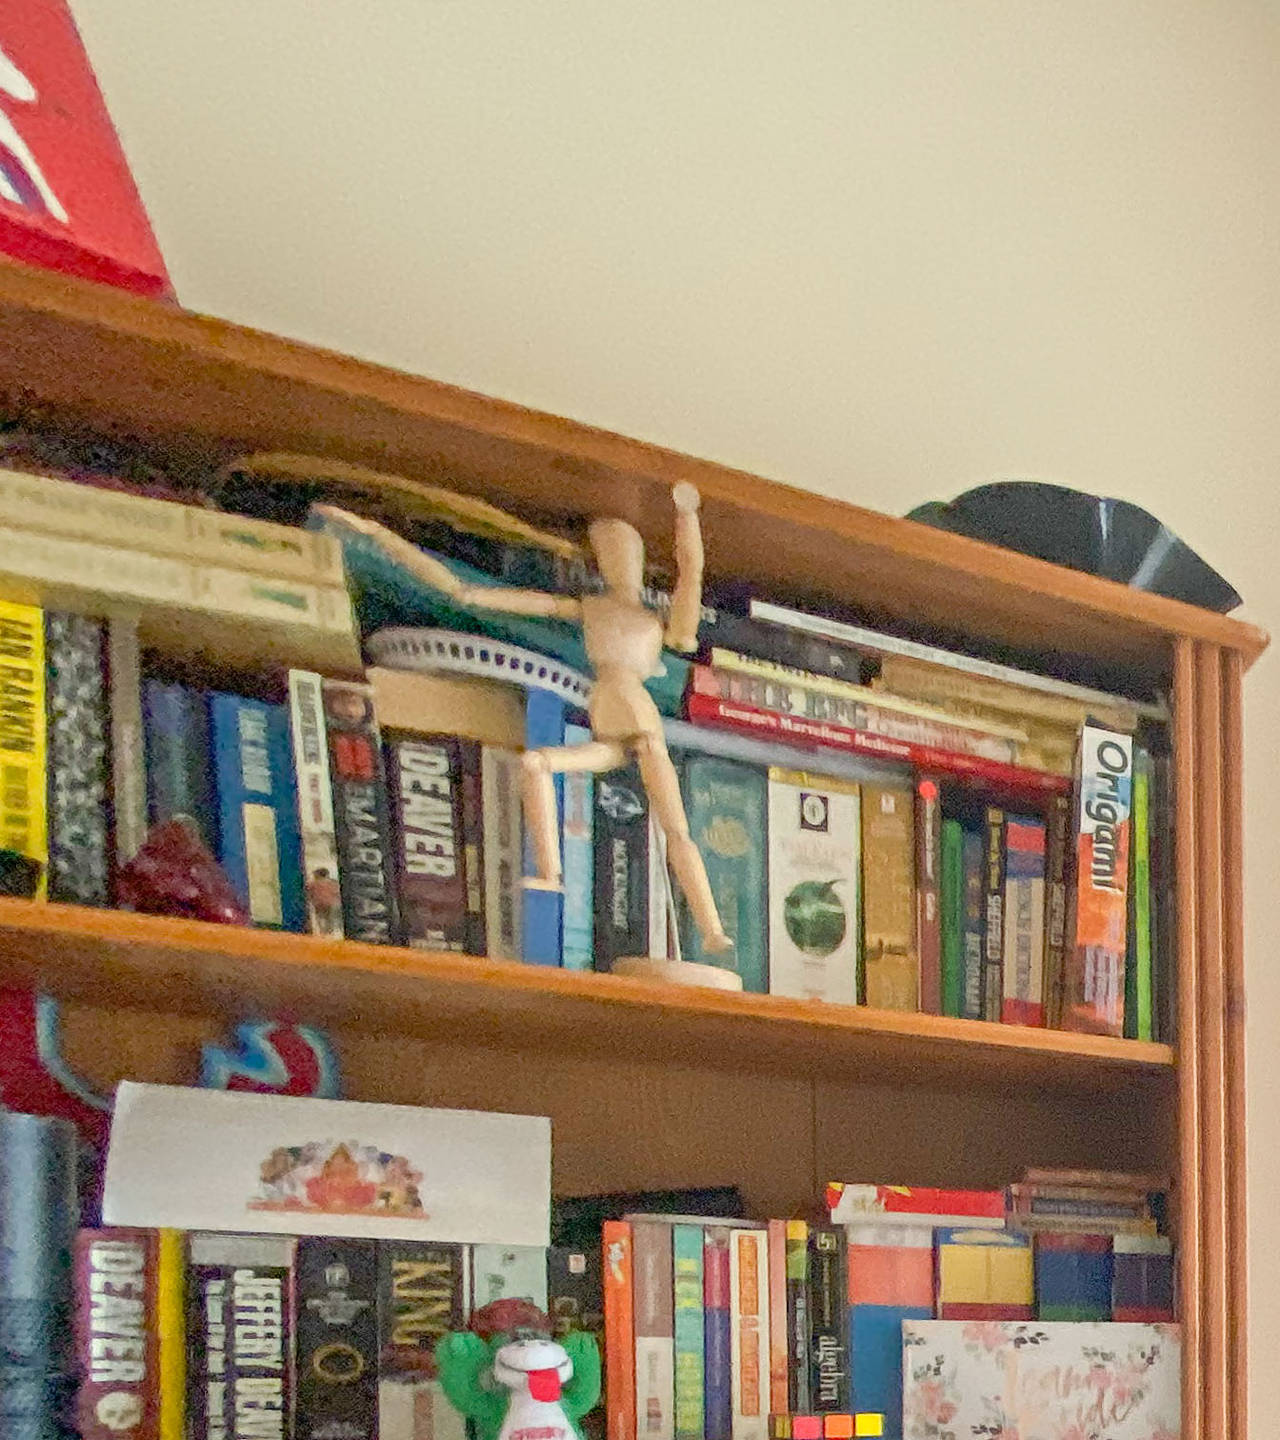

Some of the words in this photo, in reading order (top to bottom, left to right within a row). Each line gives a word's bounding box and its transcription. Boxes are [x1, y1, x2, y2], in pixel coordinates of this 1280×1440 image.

[347, 797, 392, 941] MARTIAN
[402, 740, 456, 878] DEAVER
[1090, 740, 1129, 896] Origami
[90, 1242, 146, 1383] DEAVER
[234, 1269, 284, 1371] JEFFERY
[814, 1335, 844, 1405] algebra
